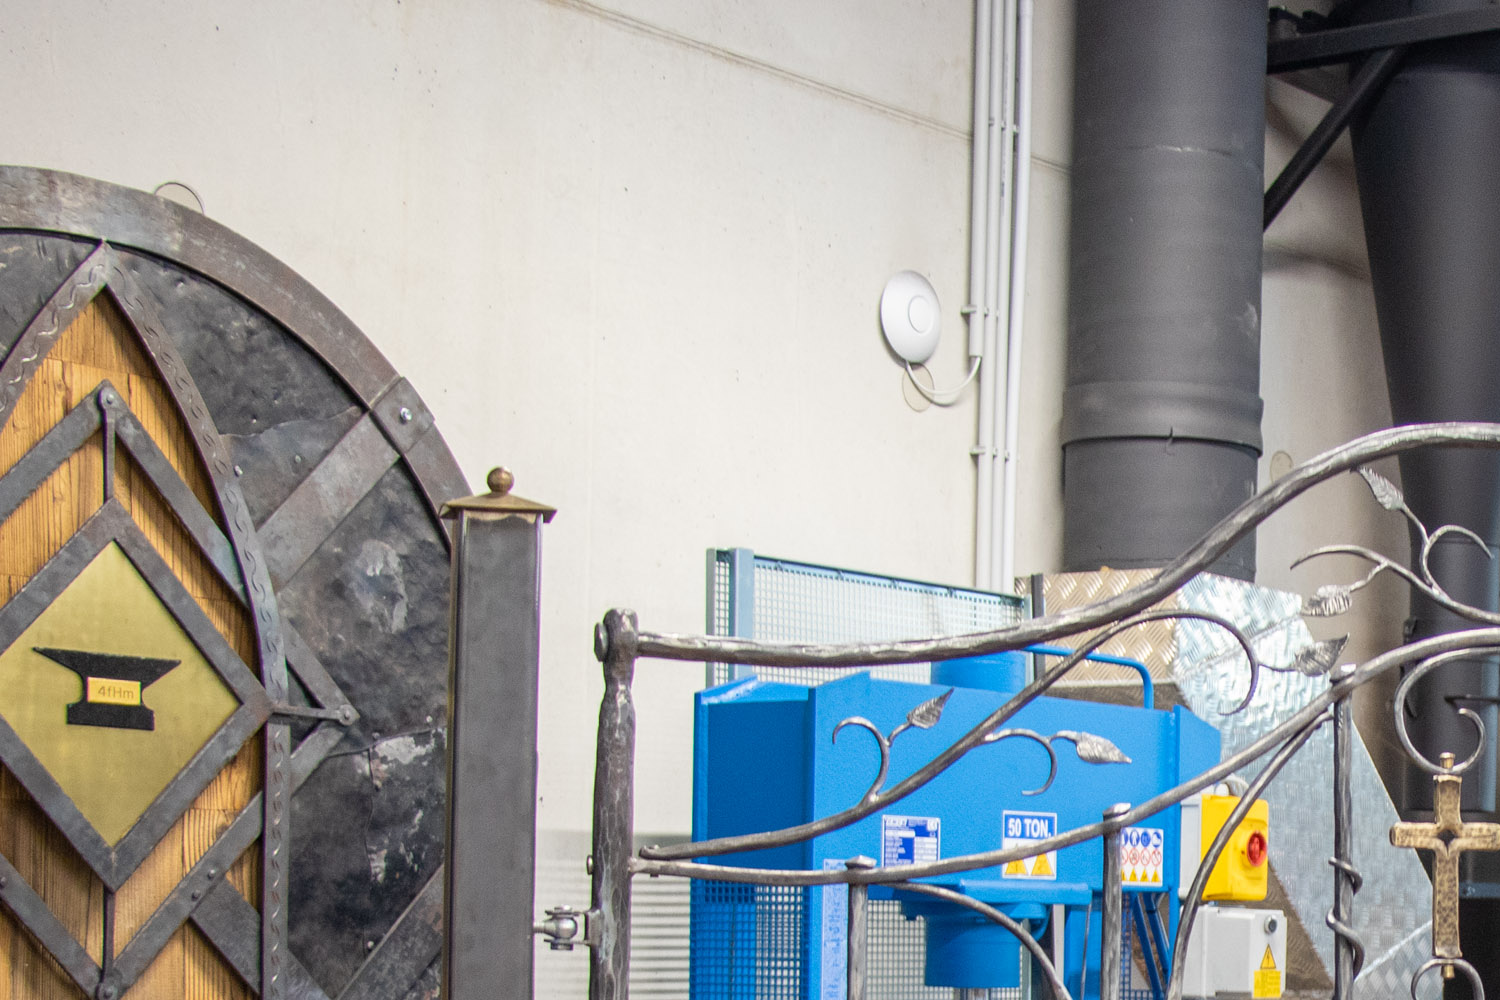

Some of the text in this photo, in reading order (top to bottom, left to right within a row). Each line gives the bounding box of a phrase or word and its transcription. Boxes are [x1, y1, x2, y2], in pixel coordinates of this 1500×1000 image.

[97, 685, 134, 699] 4fHm
[1008, 817, 1052, 838] 50 TON.
